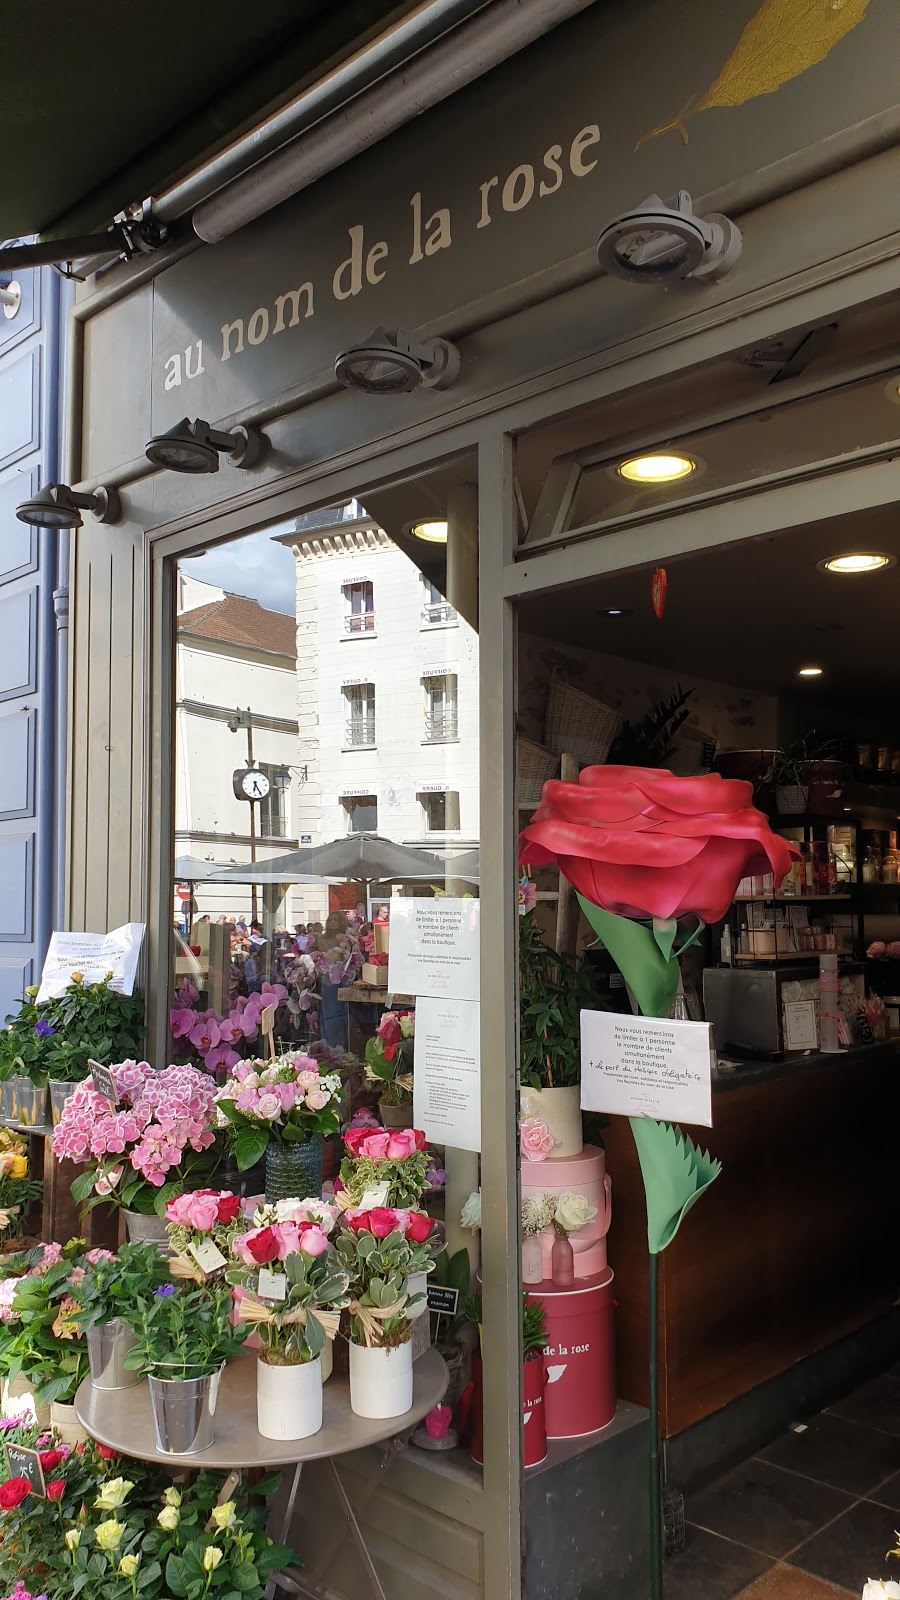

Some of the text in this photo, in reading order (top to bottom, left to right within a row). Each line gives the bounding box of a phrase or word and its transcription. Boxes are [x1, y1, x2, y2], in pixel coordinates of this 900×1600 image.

[163, 124, 601, 390] au nom de la rose
[624, 1051, 665, 1060] simultanément
[642, 1060, 668, 1069] boutique.
[558, 1344, 568, 1356] la
[571, 1344, 590, 1354] rose
[528, 1399, 532, 1407] la
